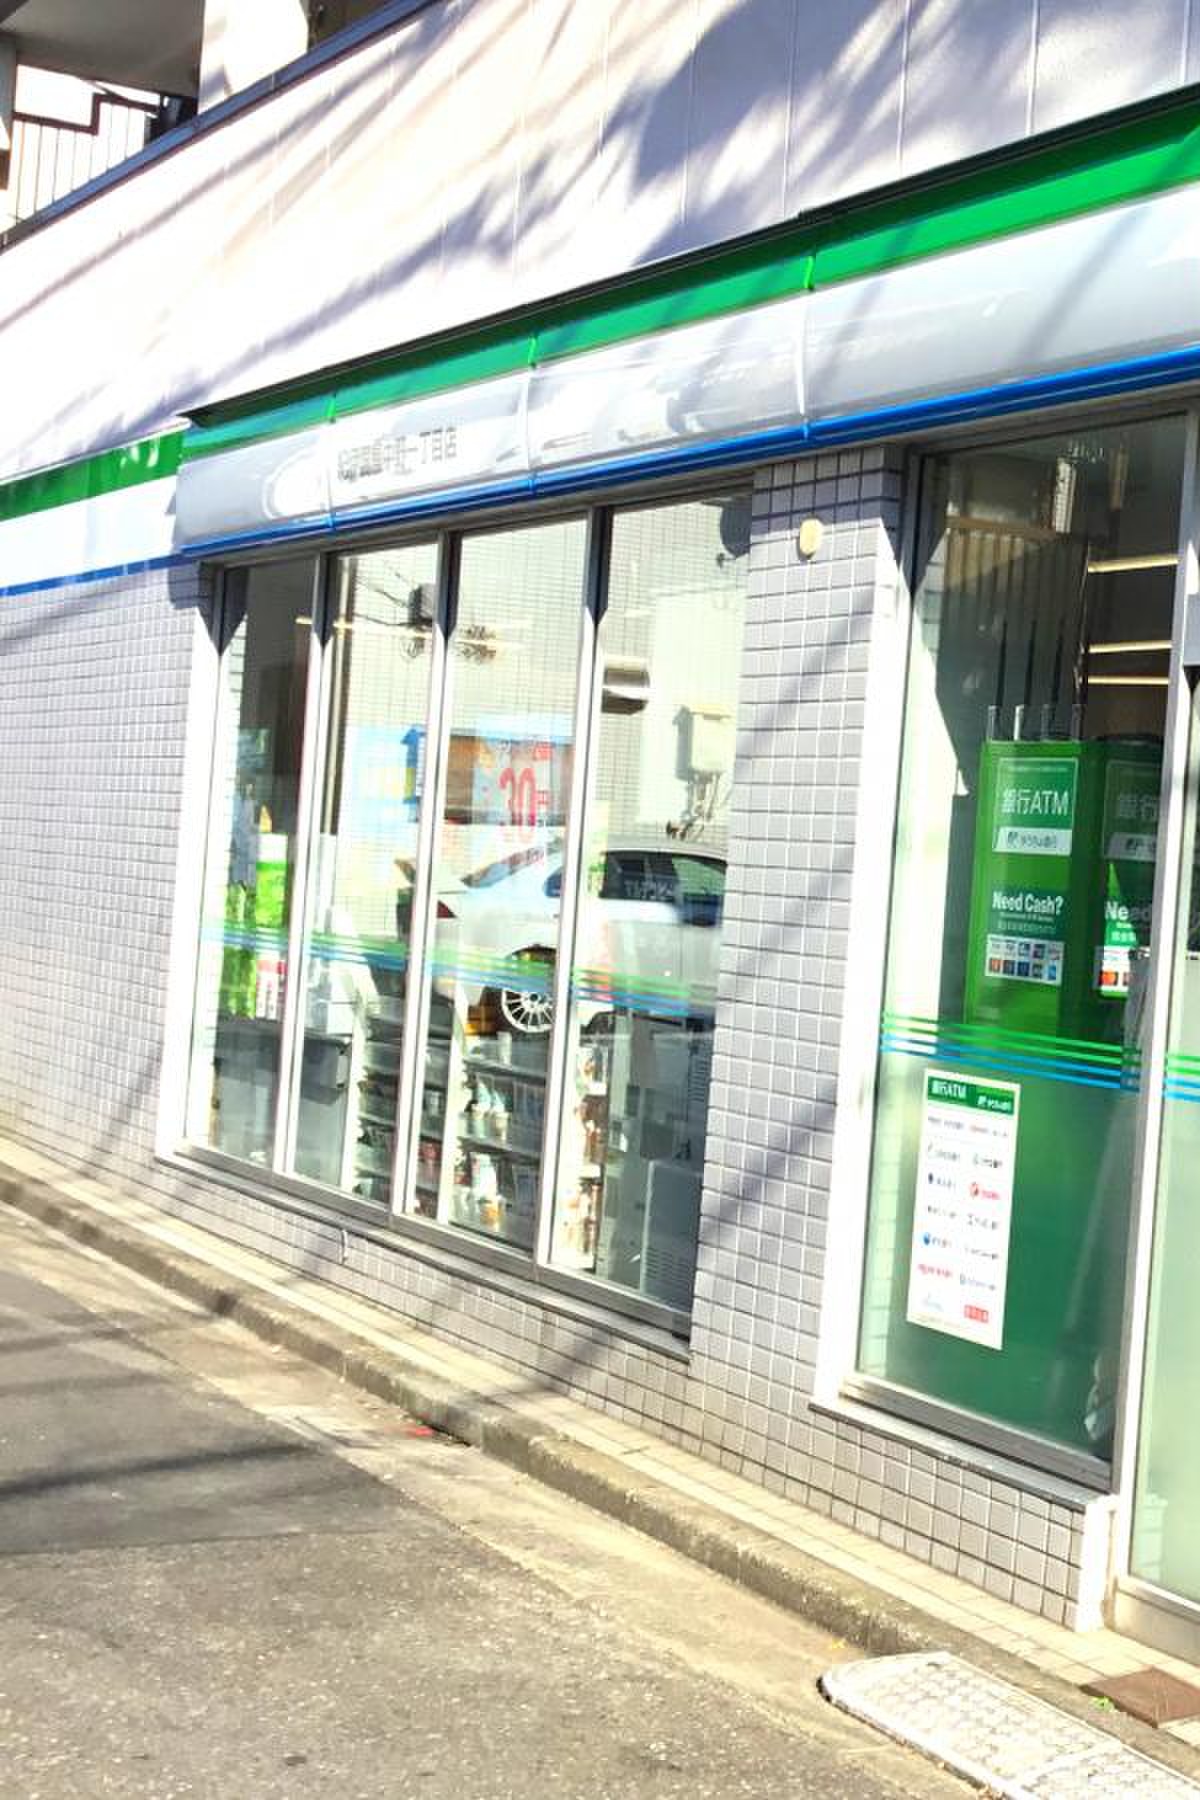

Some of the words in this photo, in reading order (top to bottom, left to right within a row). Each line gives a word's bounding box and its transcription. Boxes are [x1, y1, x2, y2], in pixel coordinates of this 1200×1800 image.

[1001, 788, 1070, 817] 銀行ATM
[991, 891, 1024, 911] Need
[1024, 894, 1063, 915] Cash?
